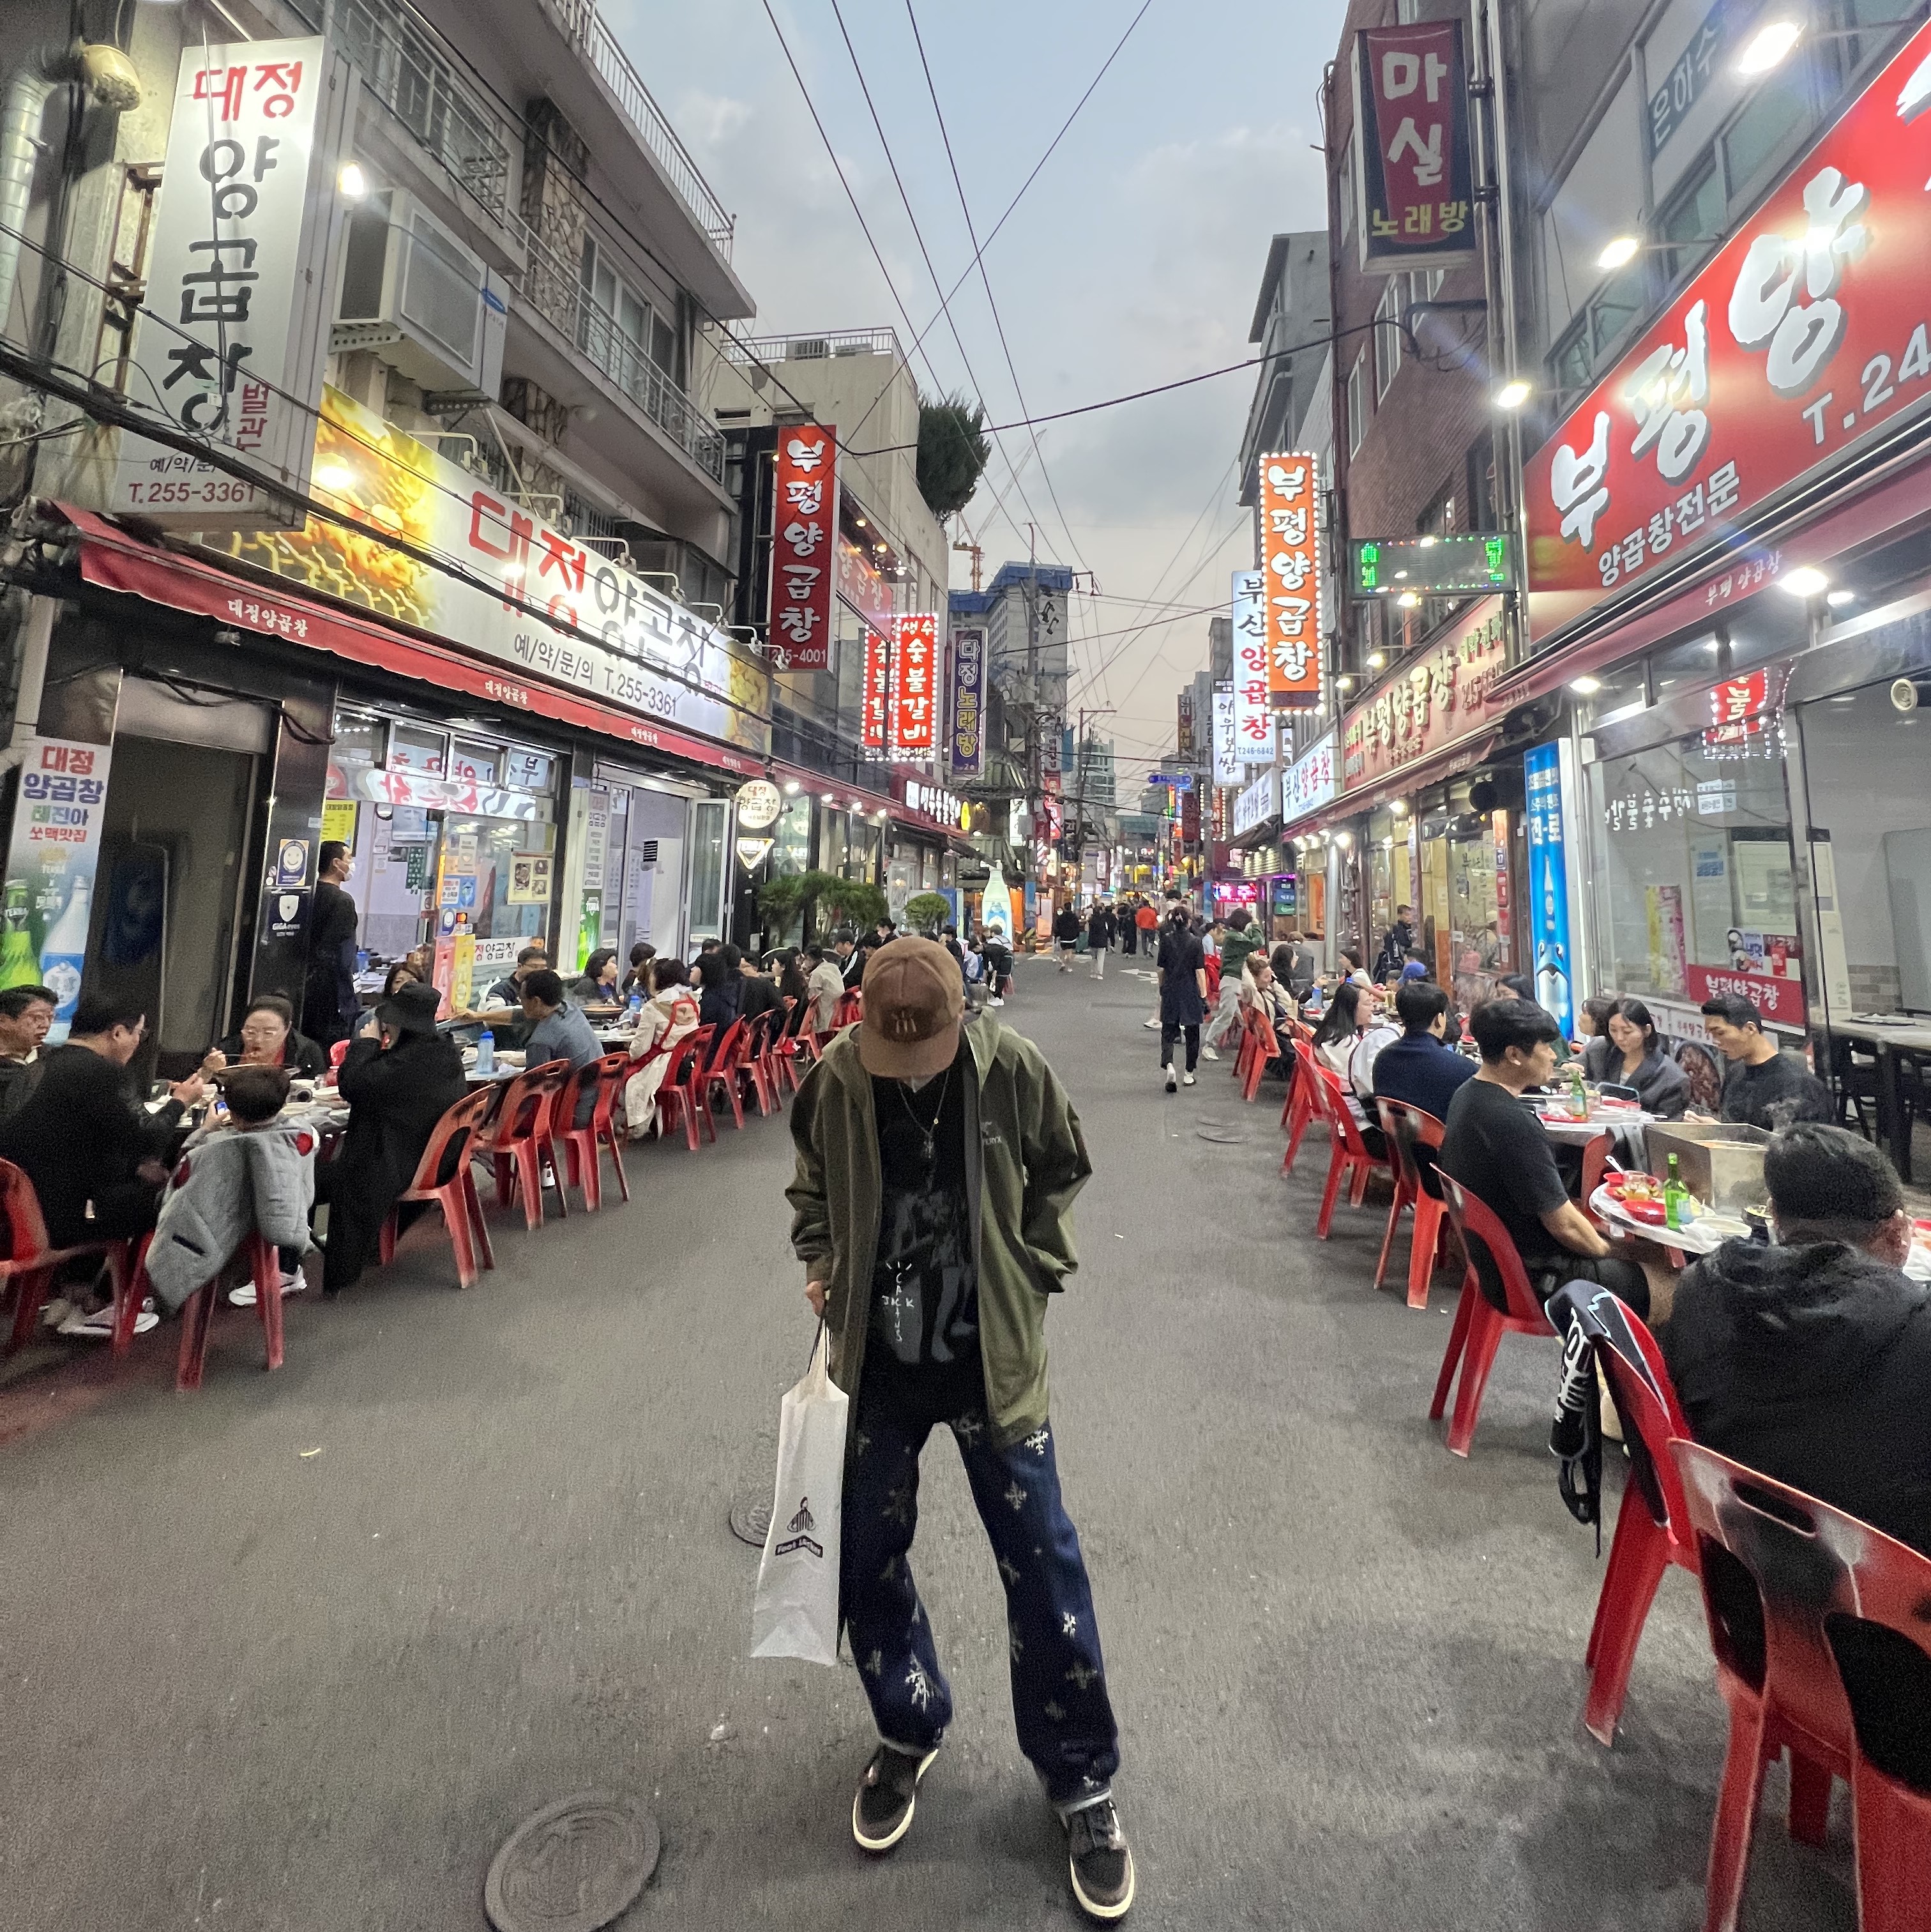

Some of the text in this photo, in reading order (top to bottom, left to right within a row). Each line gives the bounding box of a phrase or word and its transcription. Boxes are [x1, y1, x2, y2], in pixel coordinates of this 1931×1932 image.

[193, 61, 303, 122] 대정
[1652, 23, 1719, 149] 은하수
[1381, 51, 1447, 186] 마실
[1372, 201, 1467, 237] 노래방
[128, 482, 255, 503] T.255-3361
[1597, 460, 1742, 586] 양곱창전문
[469, 491, 587, 637] 대정
[778, 439, 826, 643] 부평양곱창
[1268, 465, 1315, 682] 부평양곱창
[771, 648, 826, 663] 25-4001
[902, 620, 934, 636] 생수
[603, 666, 678, 717] T.255-3361
[901, 638, 930, 740] 숯불갈비
[23, 773, 104, 805] 양곱창
[41, 745, 95, 775] 대정
